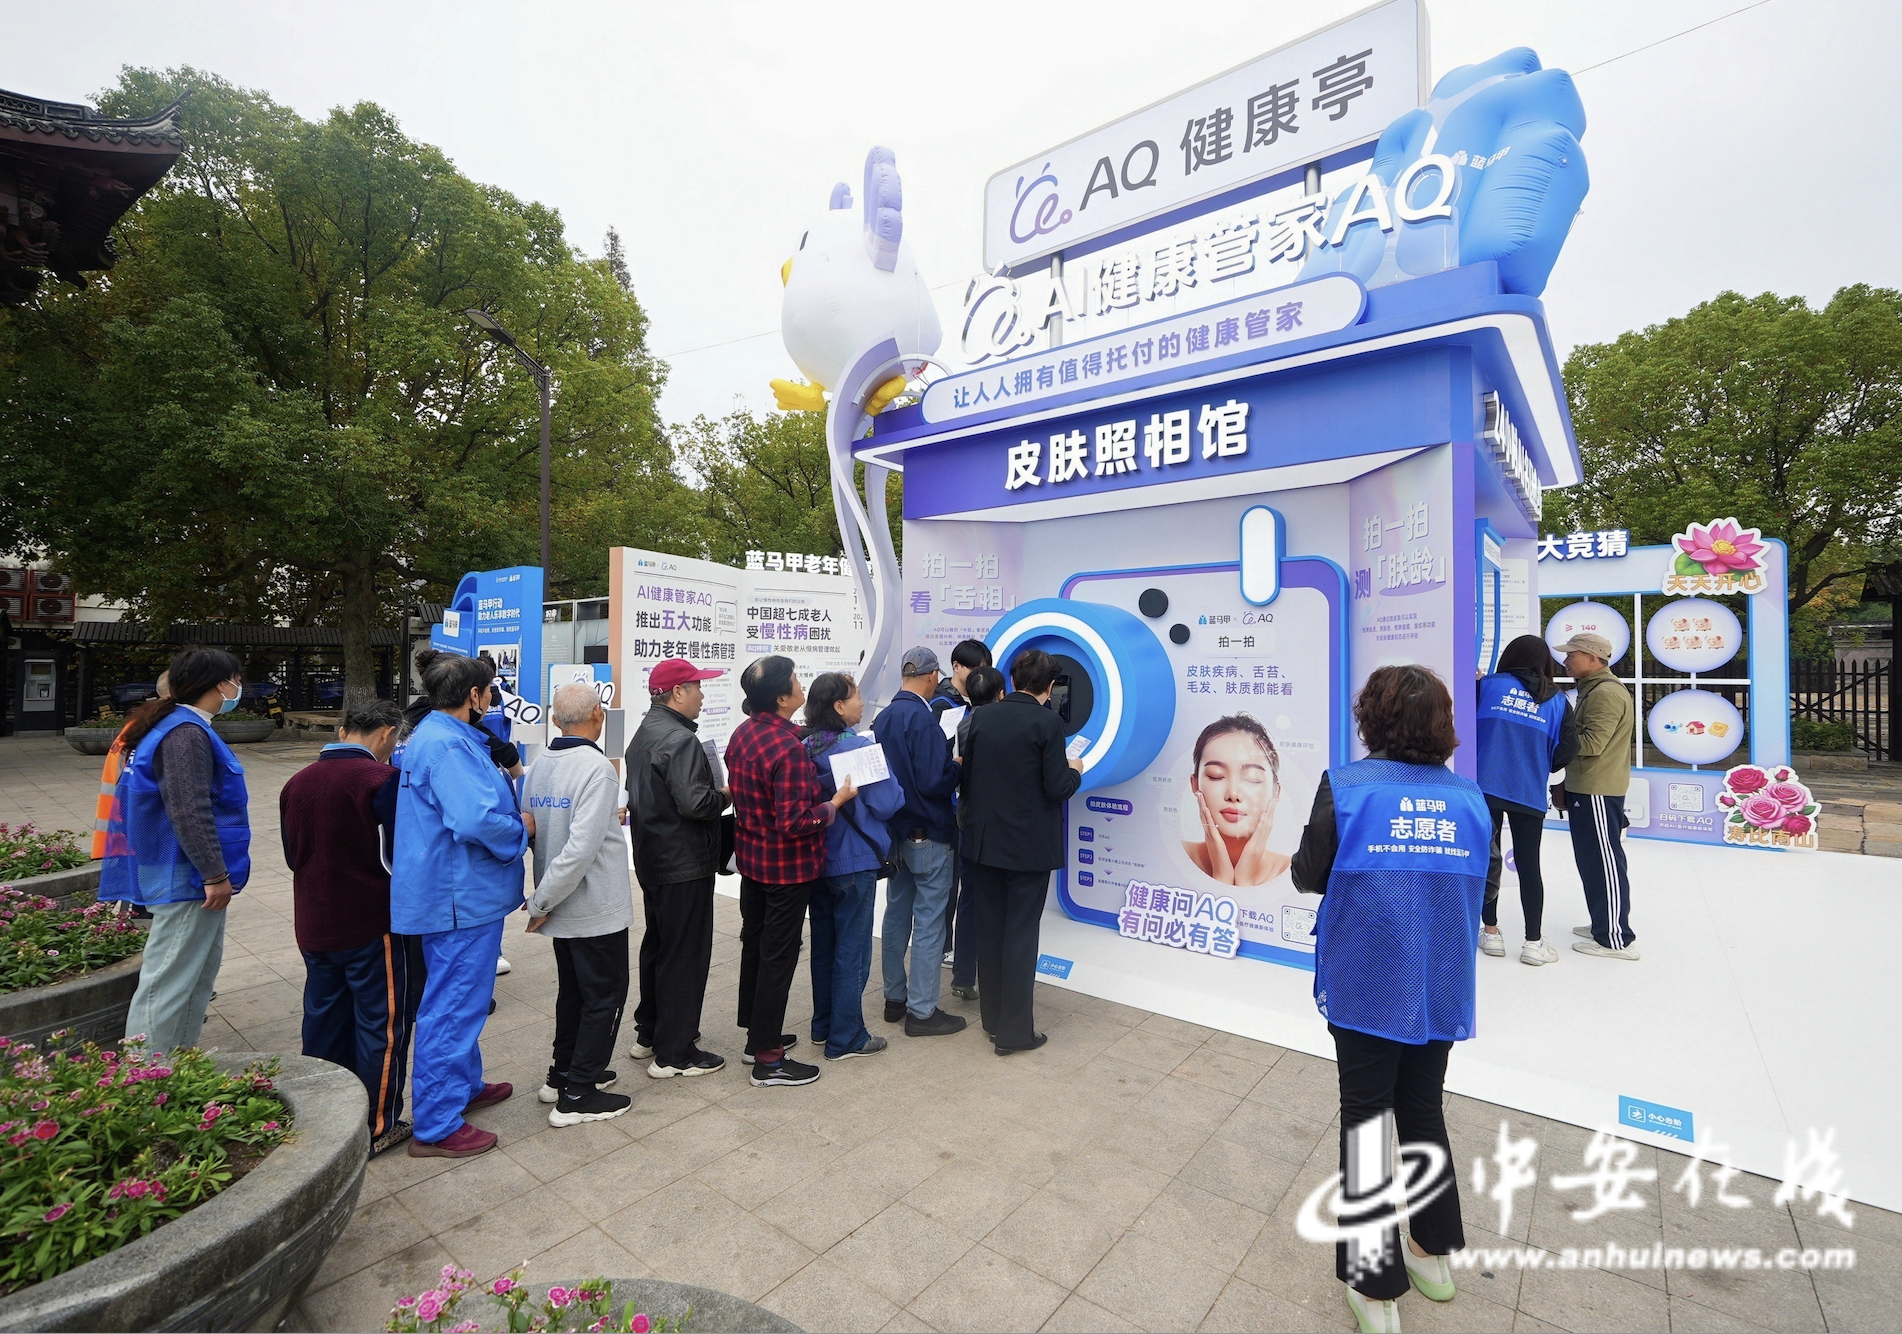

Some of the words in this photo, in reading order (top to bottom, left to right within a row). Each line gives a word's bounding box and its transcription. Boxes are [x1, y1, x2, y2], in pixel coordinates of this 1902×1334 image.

[1079, 139, 1160, 212] AQ
[1180, 46, 1374, 172] 健康亭
[1470, 146, 1511, 170] 蓝马甲
[1039, 153, 1460, 328] AI健康管家AQ
[953, 300, 1304, 409] 让人人拥有值得托付的健康管家
[1004, 399, 1250, 491] 皮肤照相馆
[1364, 501, 1430, 552] 拍一拍
[1537, 530, 1628, 561] 大竞猜
[922, 552, 1000, 580] 拍一拍
[1667, 572, 1762, 592] 天天开心
[637, 585, 713, 607] AI健康管家AQ
[636, 609, 712, 632] 推出五大功能
[747, 606, 832, 622] 中国超七成老人
[1209, 615, 1231, 624] 蓝马甲
[1257, 613, 1274, 623] AQ
[747, 622, 831, 641] 受慢性病困扰
[1218, 635, 1255, 648] 拍一拍
[634, 638, 735, 660] 助力老年慢性病管理
[1186, 665, 1286, 679] 皮肤疾病、舌苔、
[1186, 681, 1293, 696] 毛发、肤质都能看
[505, 698, 541, 724] AQ
[1501, 695, 1540, 714] 志愿者
[1415, 799, 1447, 812] 蓝马甲
[1390, 816, 1457, 843] 志愿者
[1660, 813, 1713, 825] 扫码下载AQ
[1728, 825, 1814, 848] 寿比南山
[1367, 845, 1406, 853] 手机不会用
[1409, 845, 1443, 854] 安全防诈骗
[1128, 883, 1235, 926] 健康问AQ
[1121, 909, 1236, 955] 有问必有答
[1648, 1112, 1682, 1127] 小心台阶
